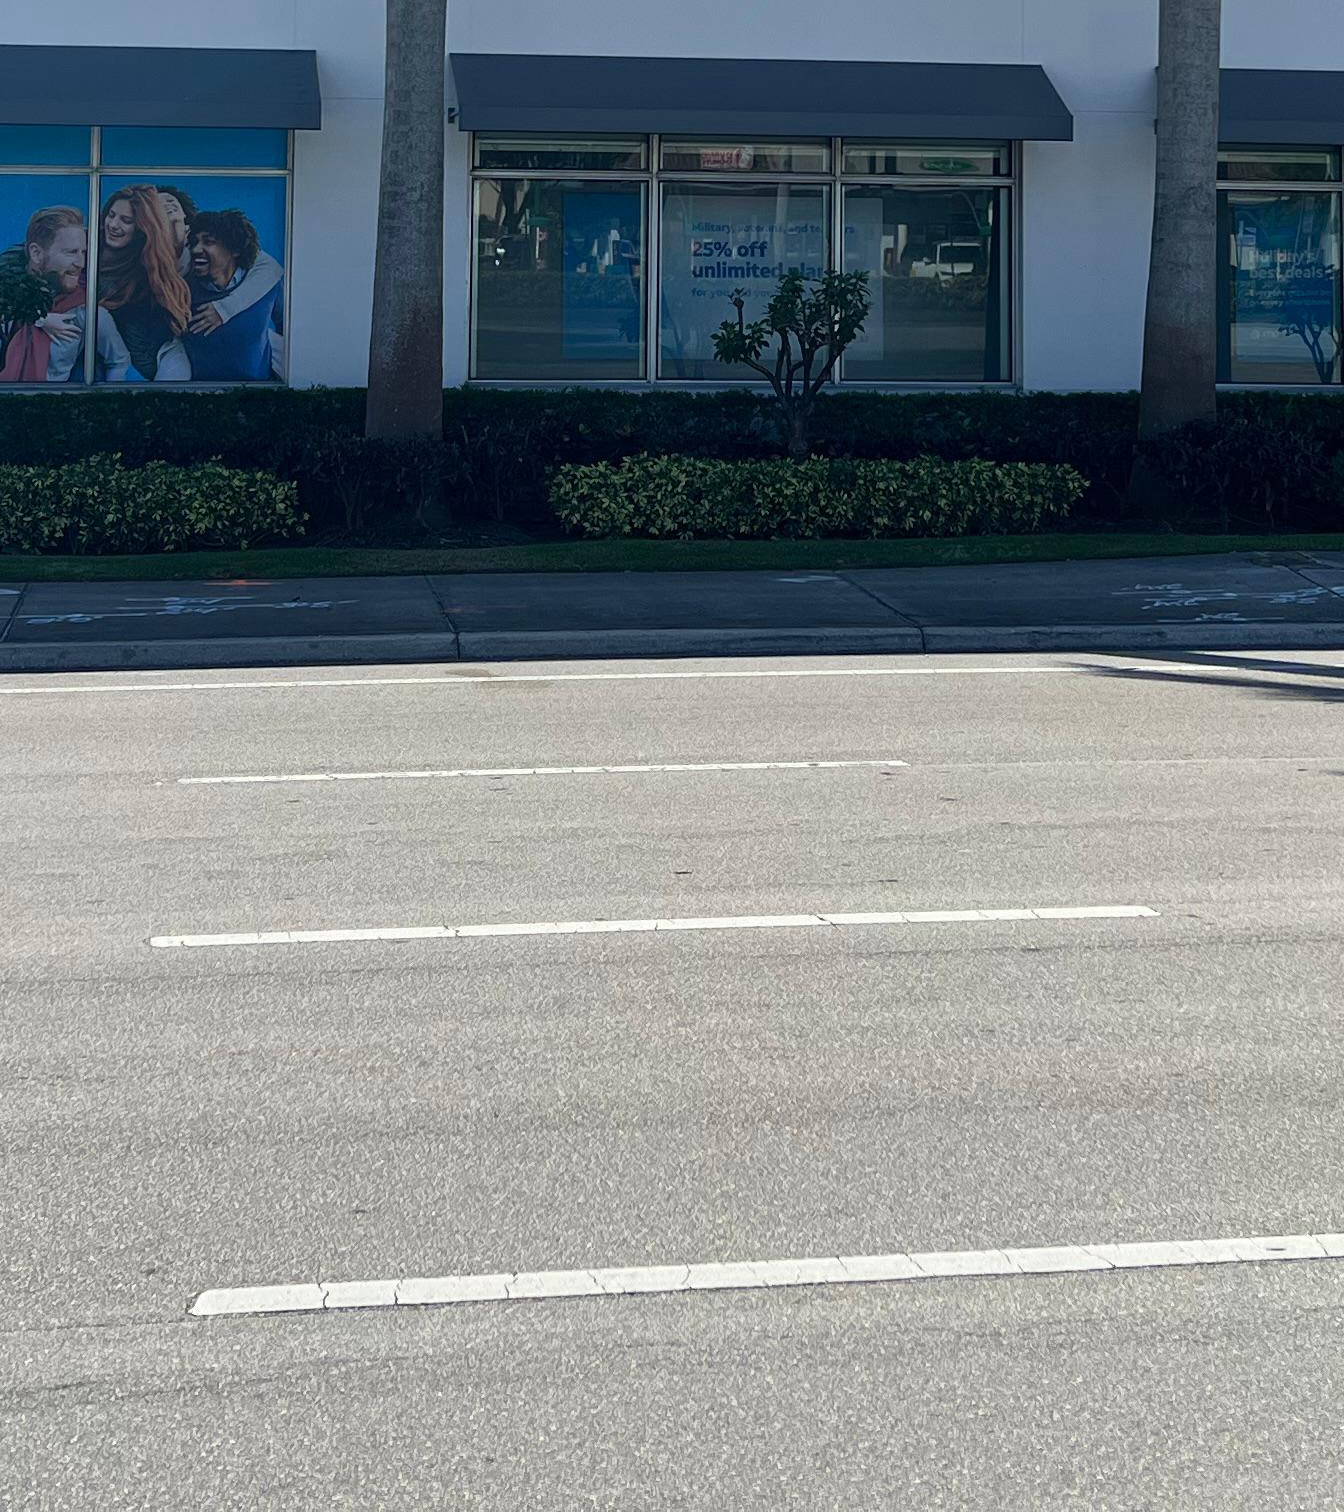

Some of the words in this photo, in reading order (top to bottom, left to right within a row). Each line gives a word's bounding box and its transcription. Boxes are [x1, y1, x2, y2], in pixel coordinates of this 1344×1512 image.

[692, 241, 732, 257] 25%
[737, 241, 768, 257] off
[692, 261, 783, 279] unlimited
[1286, 266, 1324, 279] deals
